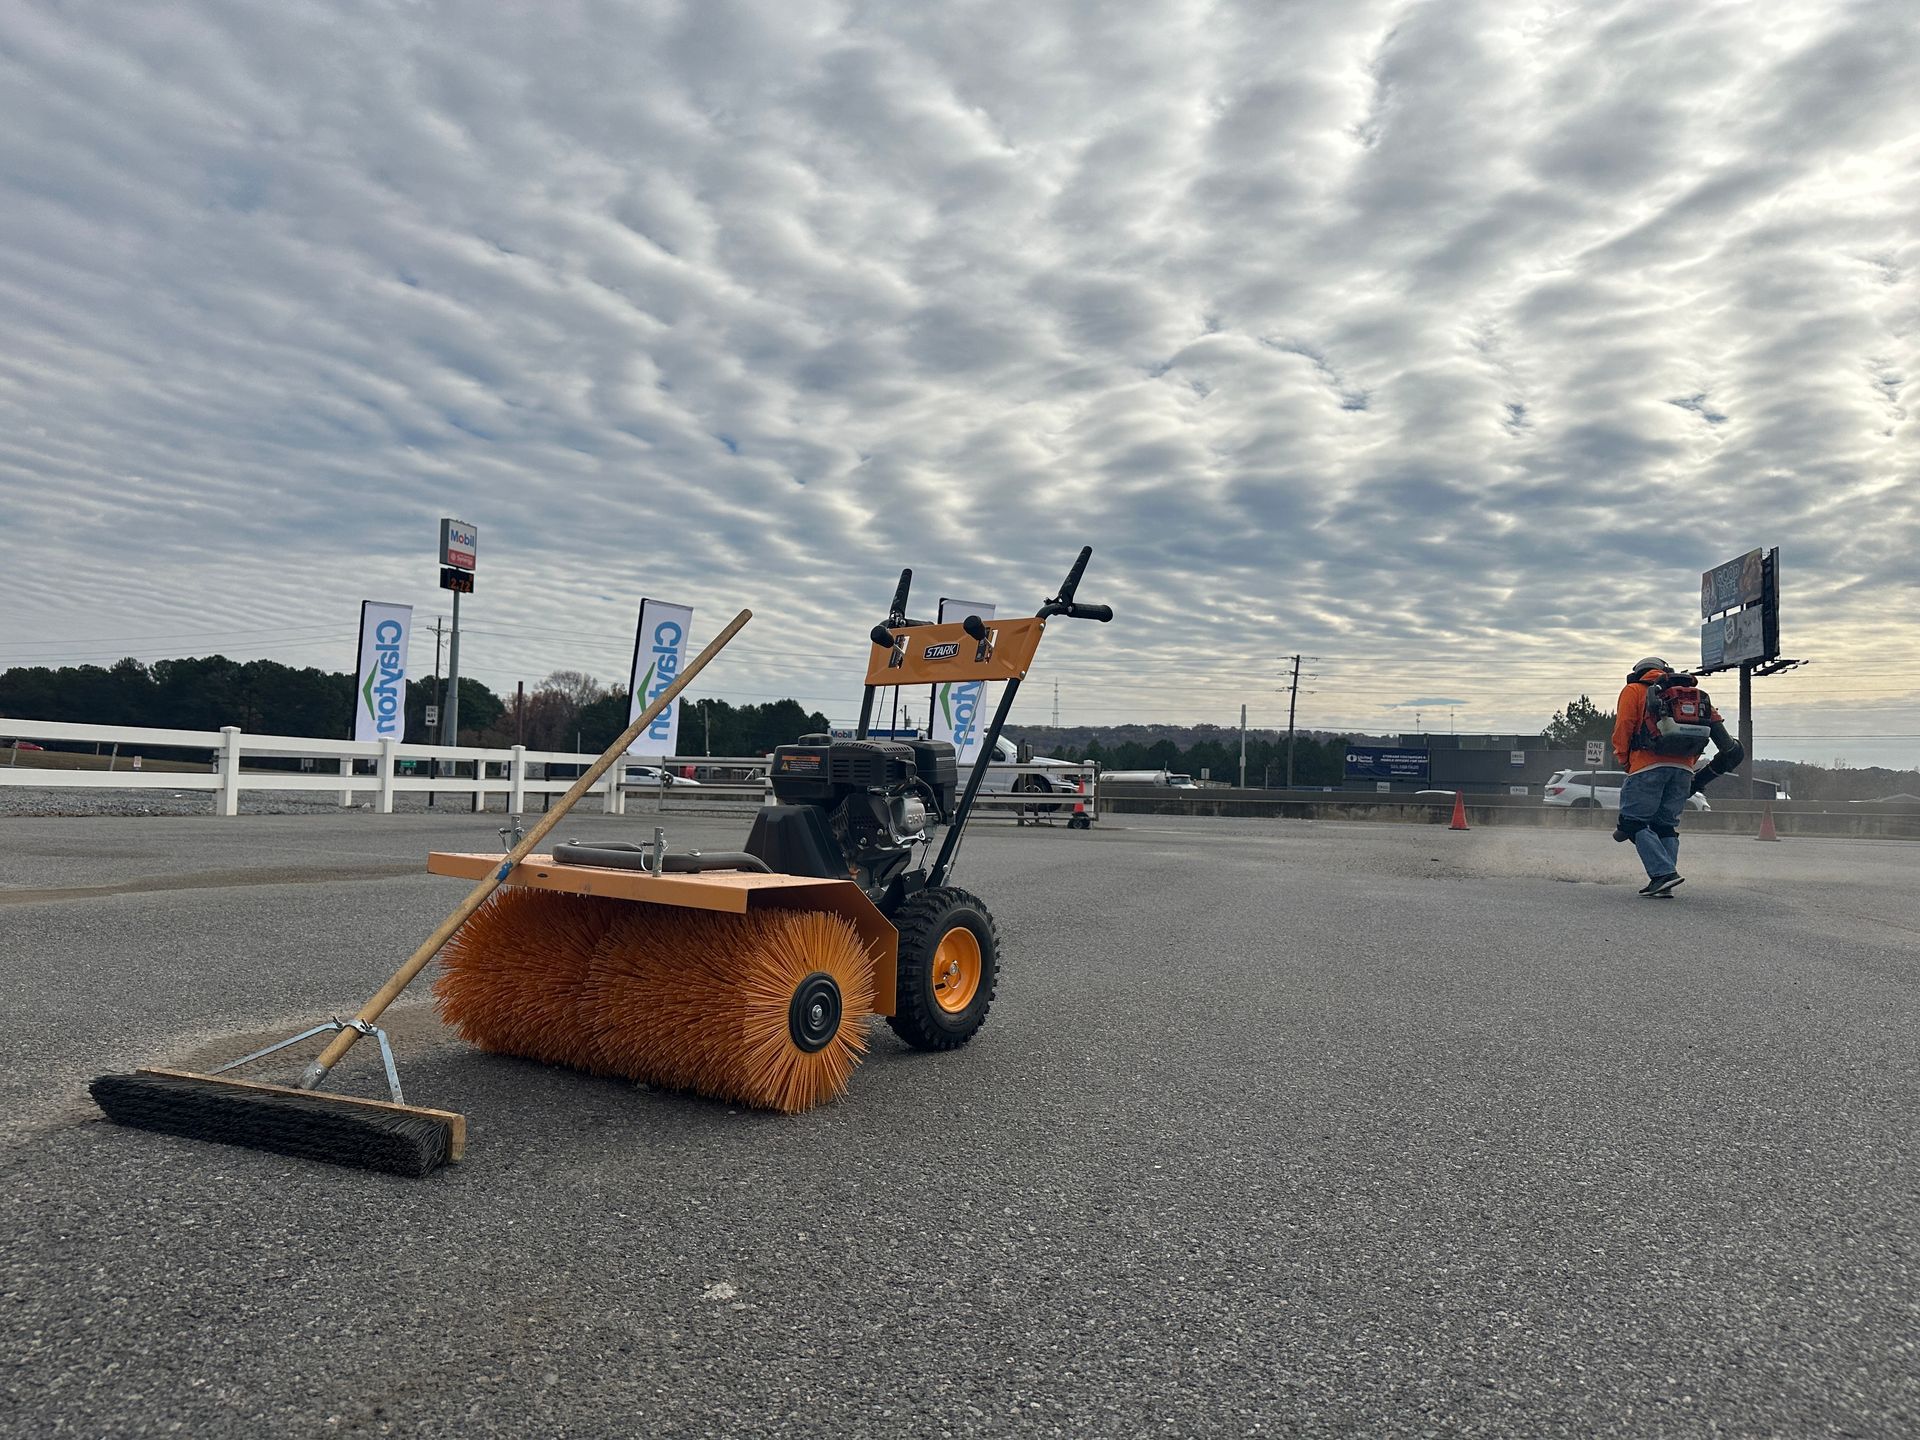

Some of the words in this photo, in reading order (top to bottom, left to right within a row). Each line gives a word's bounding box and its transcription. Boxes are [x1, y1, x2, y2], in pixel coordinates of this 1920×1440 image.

[450, 529, 475, 548] Mobil
[926, 644, 957, 658] STARK
[830, 730, 853, 739] Mobil
